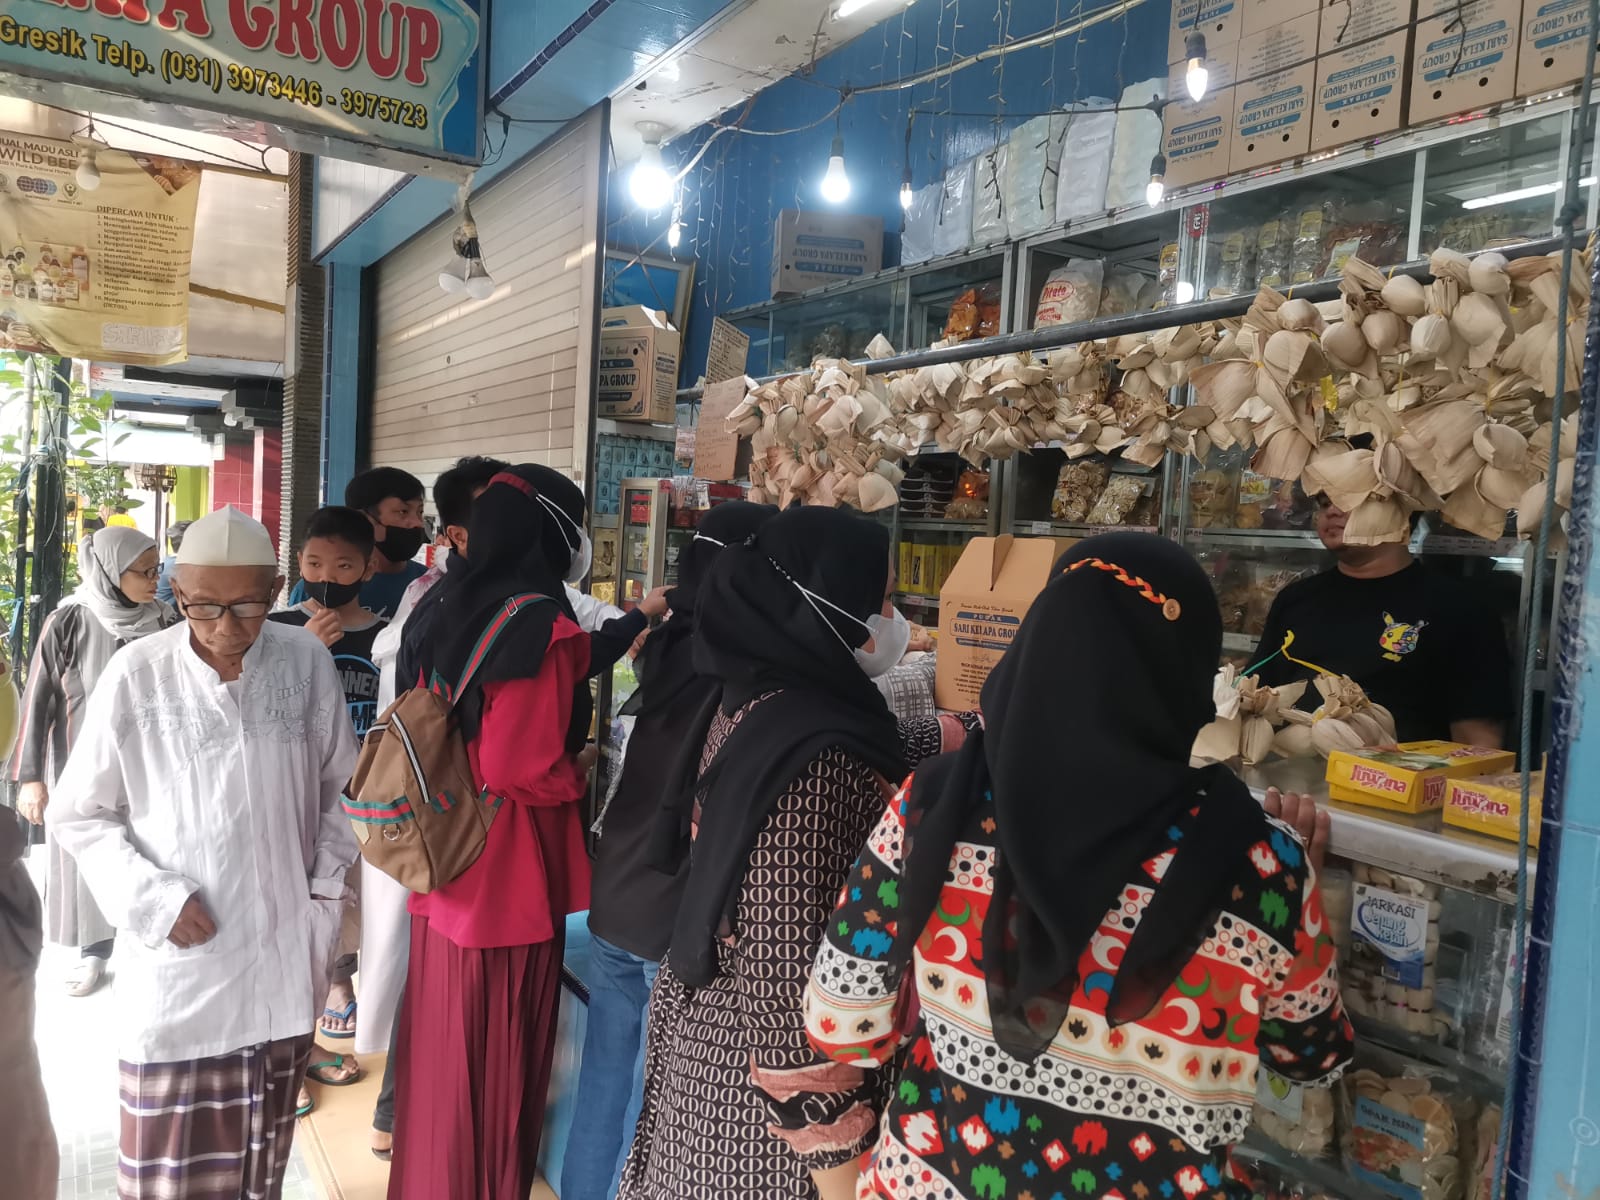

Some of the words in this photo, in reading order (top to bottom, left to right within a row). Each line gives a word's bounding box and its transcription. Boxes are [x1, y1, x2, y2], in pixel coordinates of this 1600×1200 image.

[1532, 16, 1564, 36] GROUP
[228, 0, 441, 86] GROUP
[1487, 34, 1508, 51] SARI
[1422, 52, 1450, 68] GROUP
[0, 15, 87, 59] Gresik
[92, 33, 154, 77] Telp.
[161, 49, 222, 93] (031)
[227, 64, 322, 107] 3973446
[326, 95, 336, 105] -
[340, 88, 427, 129] 3975723
[1379, 69, 1396, 80] SARI
[1348, 75, 1378, 90] KELAPA
[1323, 84, 1348, 99] GROUP
[1262, 102, 1287, 118] KELAPA
[1288, 97, 1304, 110] SARI
[1240, 110, 1262, 125] GROUP
[24, 142, 56, 154] MADU
[58, 148, 79, 157] ASLI
[0, 148, 43, 164] WILD
[47, 155, 78, 170] BEE
[97, 205, 143, 217] DIPERCAYA
[145, 211, 174, 222] UNTUK
[792, 248, 818, 258] GROUP
[610, 373, 636, 387] GROUP
[953, 622, 969, 633] SARI
[997, 627, 1017, 639] GROU
[1350, 765, 1407, 793] Juwana
[1449, 787, 1509, 816] Juwana
